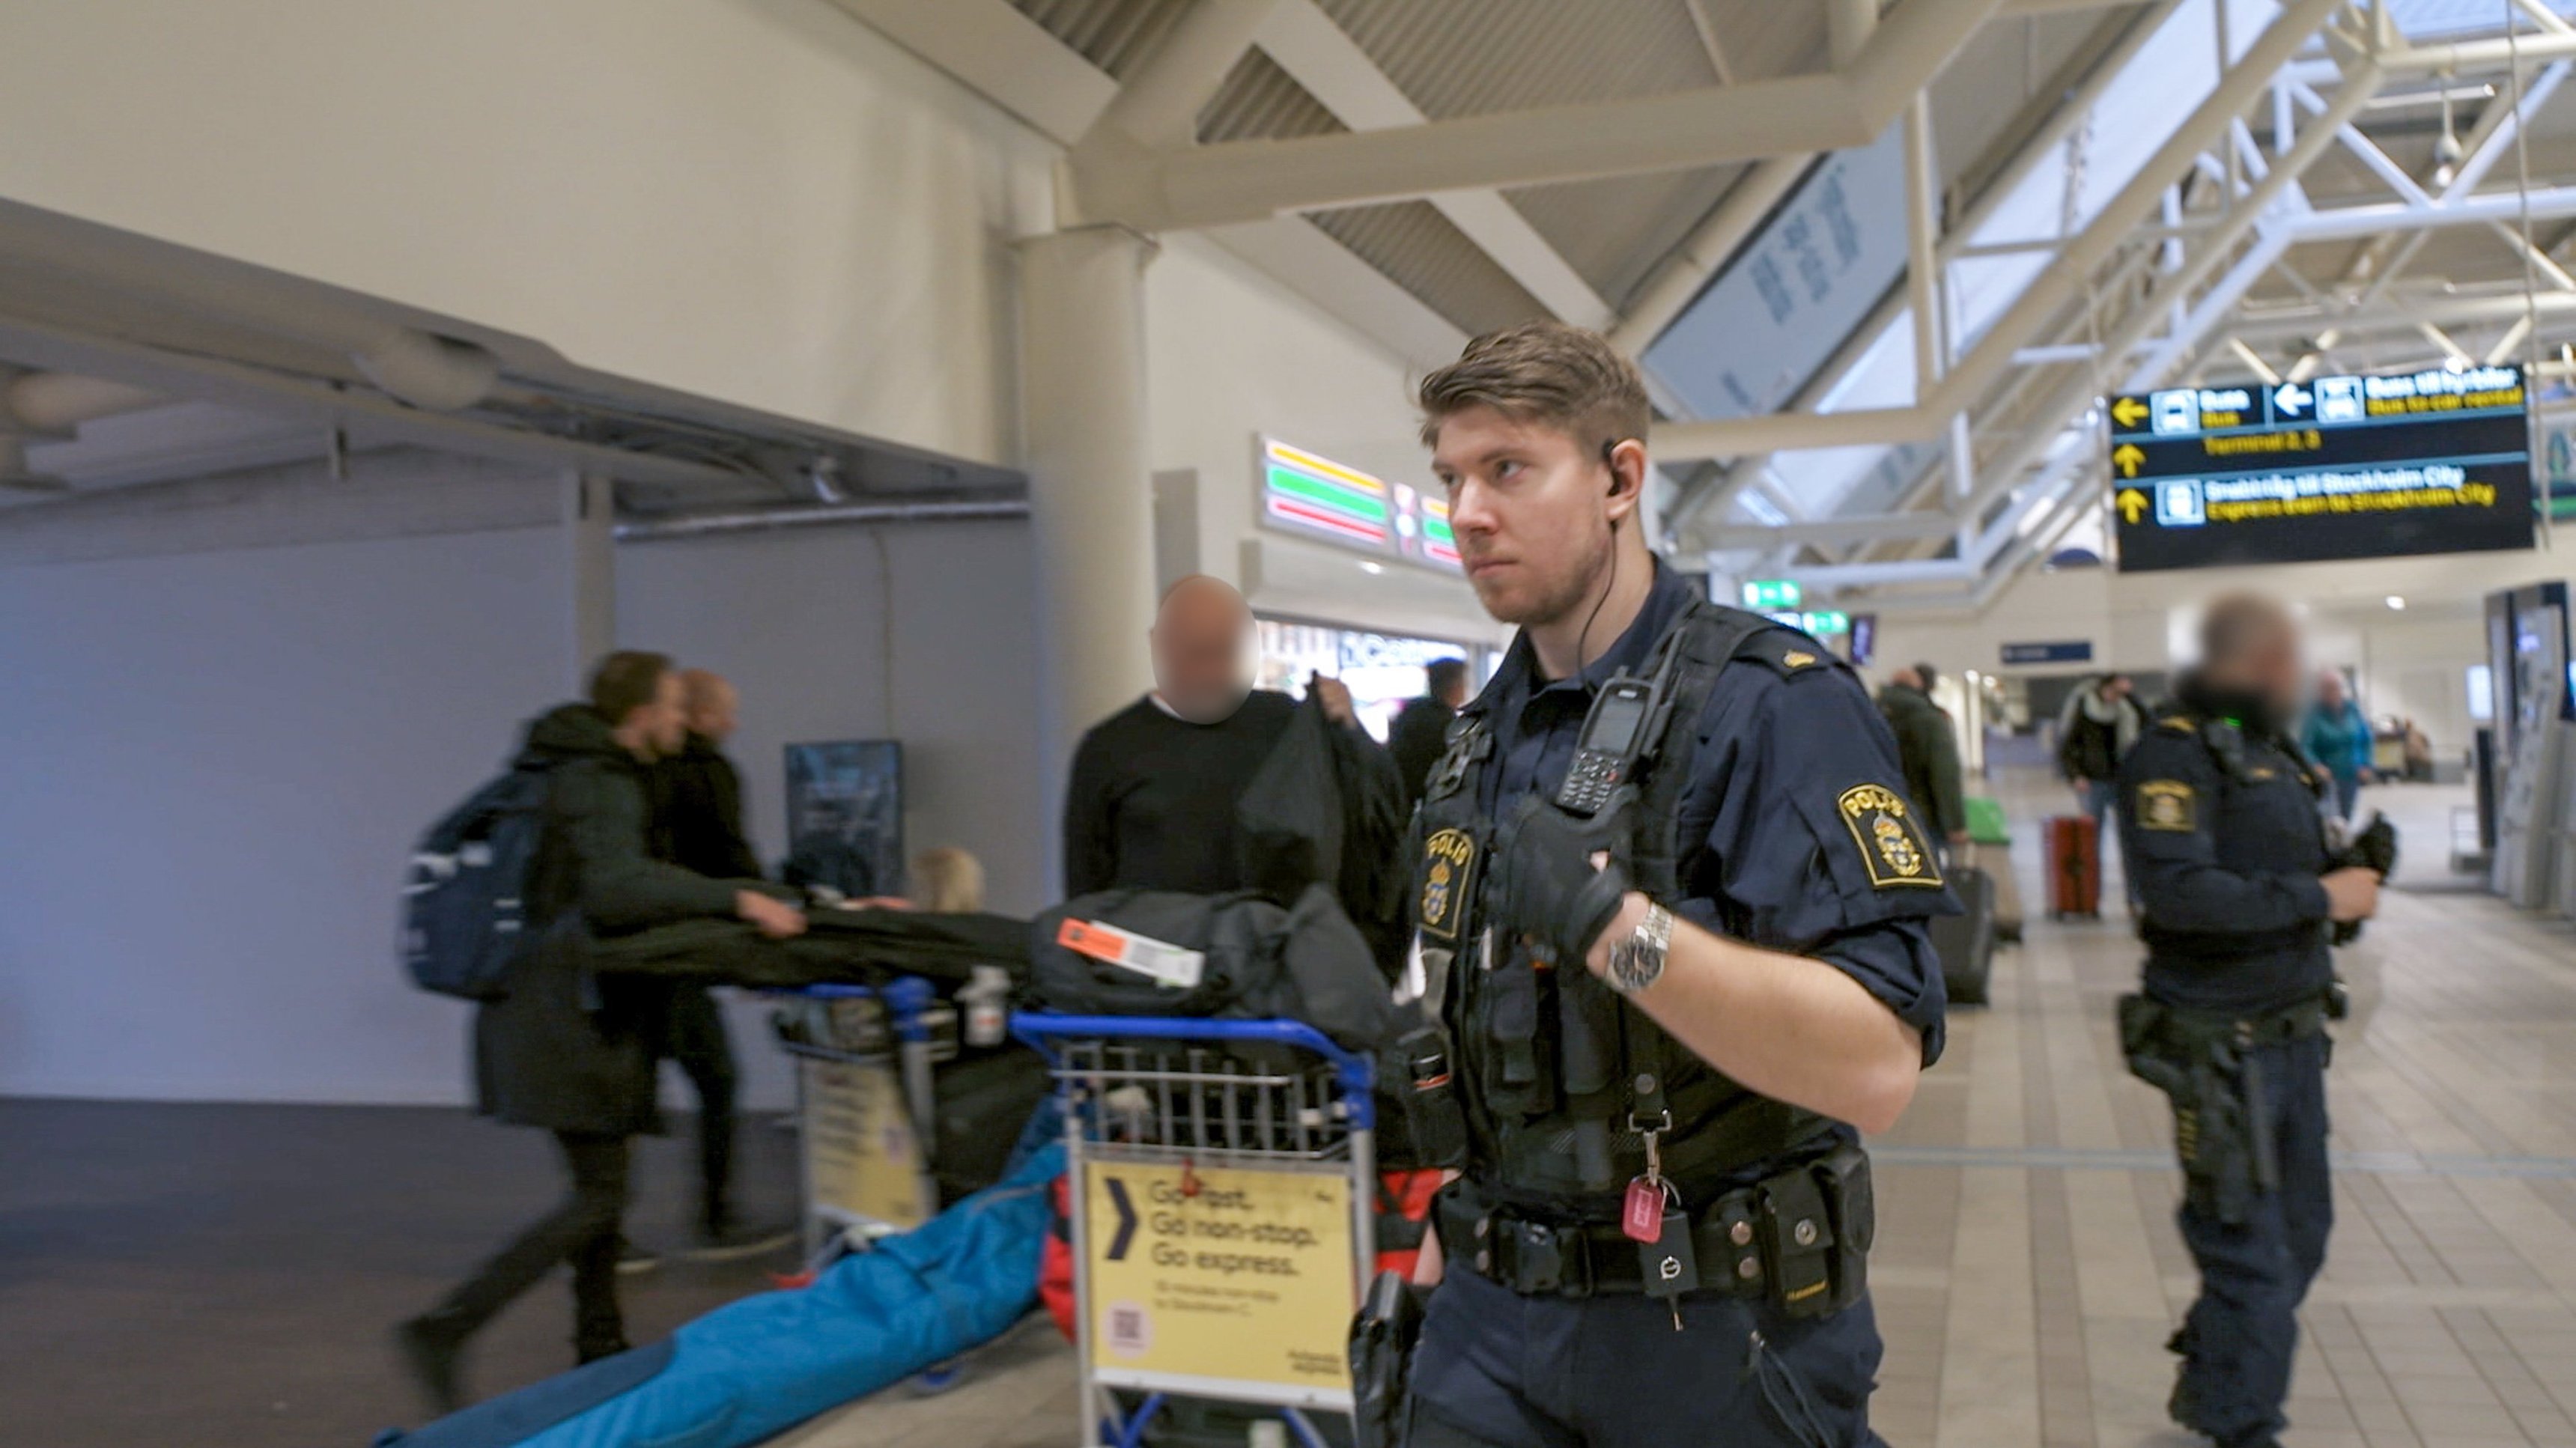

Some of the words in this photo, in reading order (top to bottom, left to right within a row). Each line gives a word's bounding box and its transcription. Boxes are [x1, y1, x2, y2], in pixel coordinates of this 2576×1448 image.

[2367, 398, 2406, 416] Bus
[2407, 395, 2428, 412] to
[2202, 412, 2240, 428] Bus
[2205, 433, 2284, 455] Terminal
[2321, 469, 2423, 495] Stockholm
[2422, 466, 2465, 490] City
[2207, 500, 2282, 523] Express
[2351, 488, 2455, 512] Stockholm
[2455, 482, 2497, 508] City
[1844, 791, 1904, 818] POLIS
[1151, 1180, 1188, 1205] Go
[1151, 1211, 1187, 1235] Go
[1194, 1220, 1320, 1249] non-stop.
[1151, 1241, 1188, 1267] Go
[1194, 1251, 1302, 1276] express.
